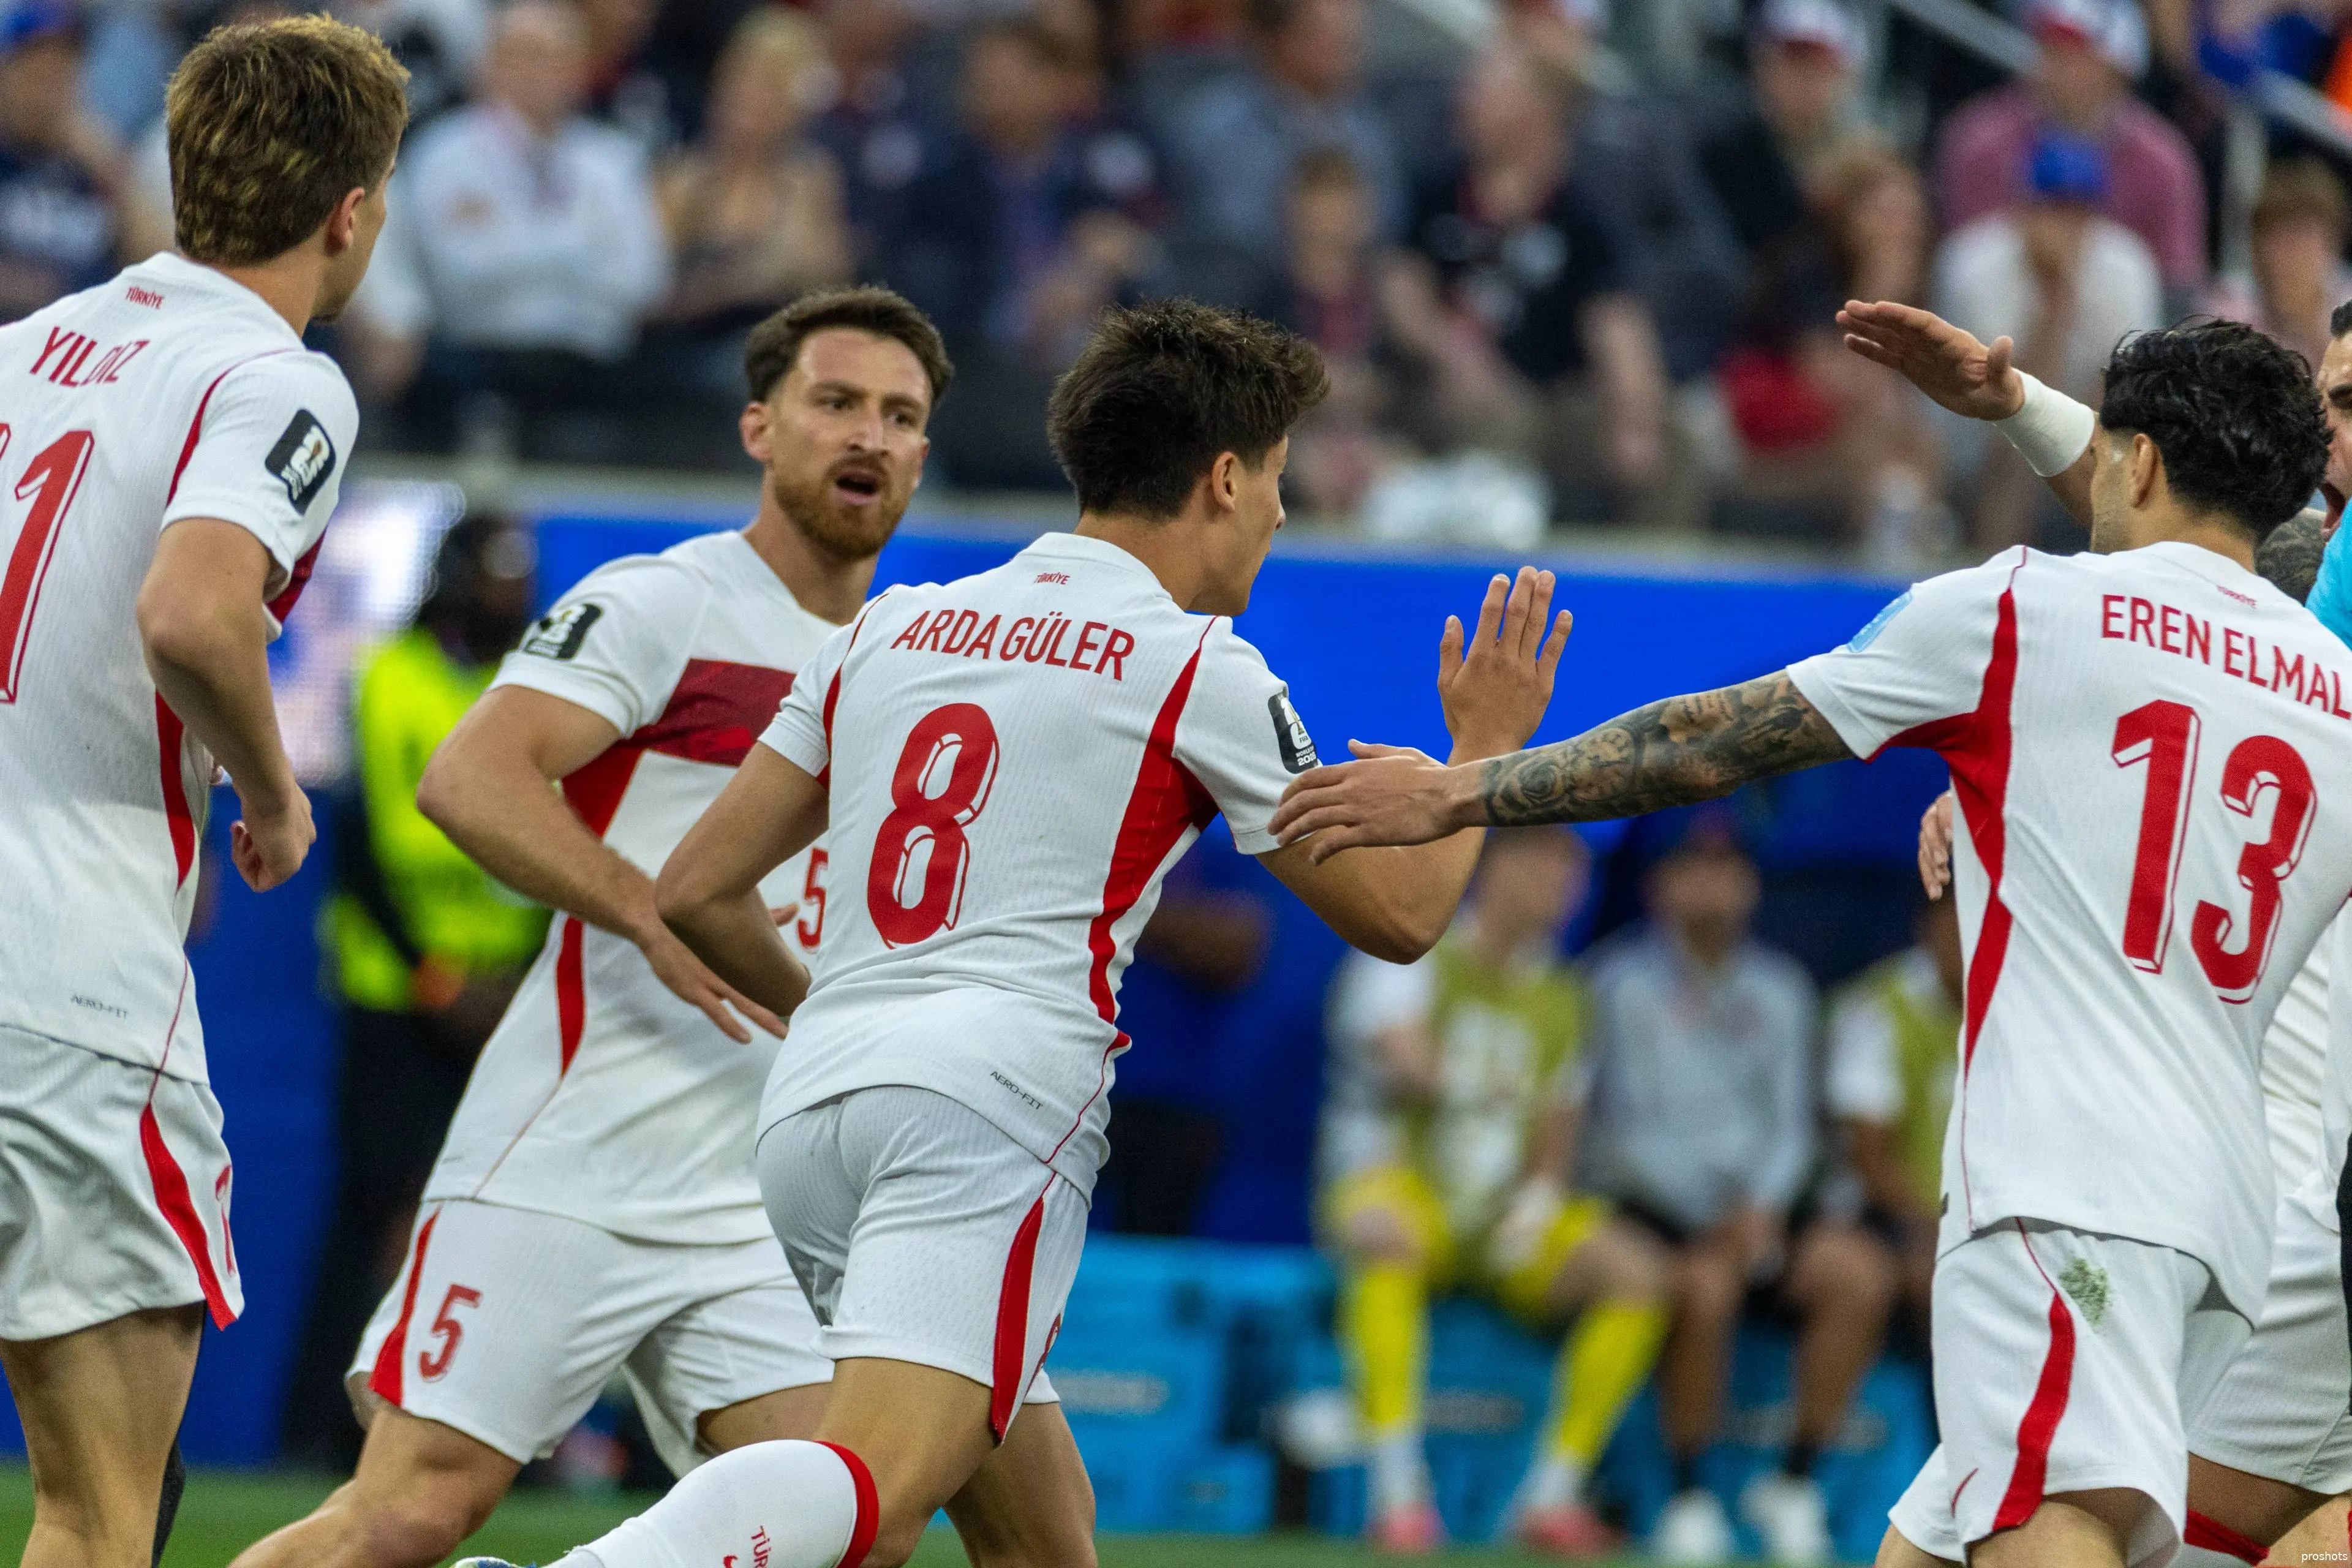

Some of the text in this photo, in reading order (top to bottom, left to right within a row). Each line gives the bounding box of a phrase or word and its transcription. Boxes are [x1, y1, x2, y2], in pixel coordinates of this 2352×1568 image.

[126, 285, 164, 309] TÜRKİYE
[29, 326, 150, 387] YILDIZ
[890, 609, 1134, 681] ARDA GÜLER
[2101, 594, 2351, 720] EREN ELMAL
[867, 703, 1000, 949] 8
[2112, 699, 2317, 1005] 13
[797, 847, 829, 954] 5
[990, 1071, 1044, 1110] AERO-FIT
[418, 1283, 483, 1383] 5
